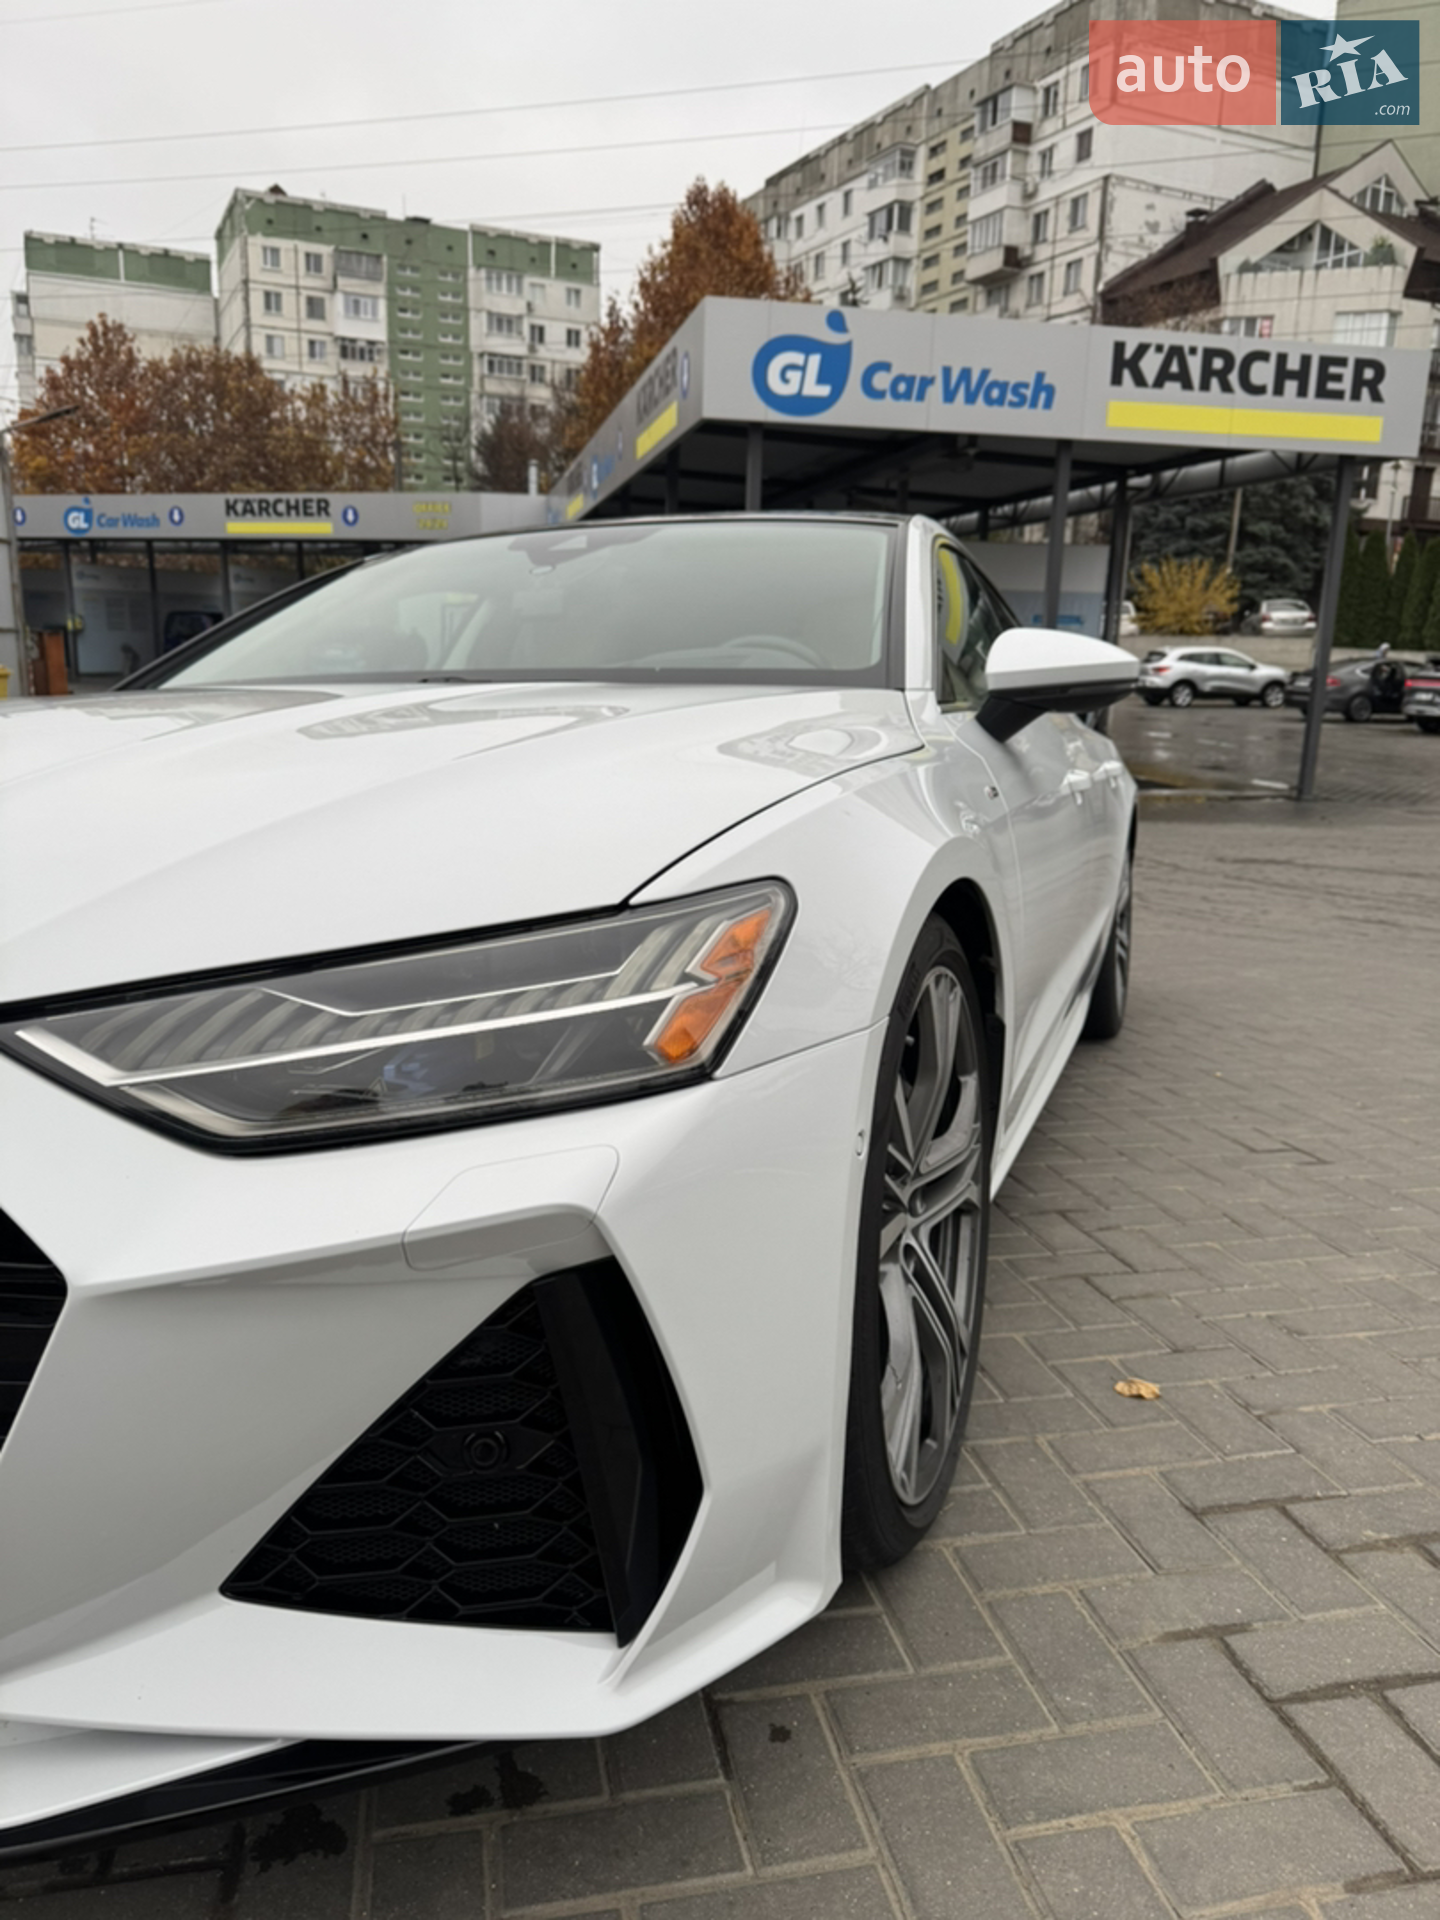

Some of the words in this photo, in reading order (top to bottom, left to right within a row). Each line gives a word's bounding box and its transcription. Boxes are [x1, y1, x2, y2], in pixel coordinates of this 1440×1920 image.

[766, 351, 833, 397] GL
[860, 361, 936, 402] Car
[941, 366, 1056, 410] Wash
[1110, 340, 1387, 403] KÄRCHER
[67, 511, 90, 529] GL
[97, 513, 119, 528] Car
[121, 512, 160, 529] Wash
